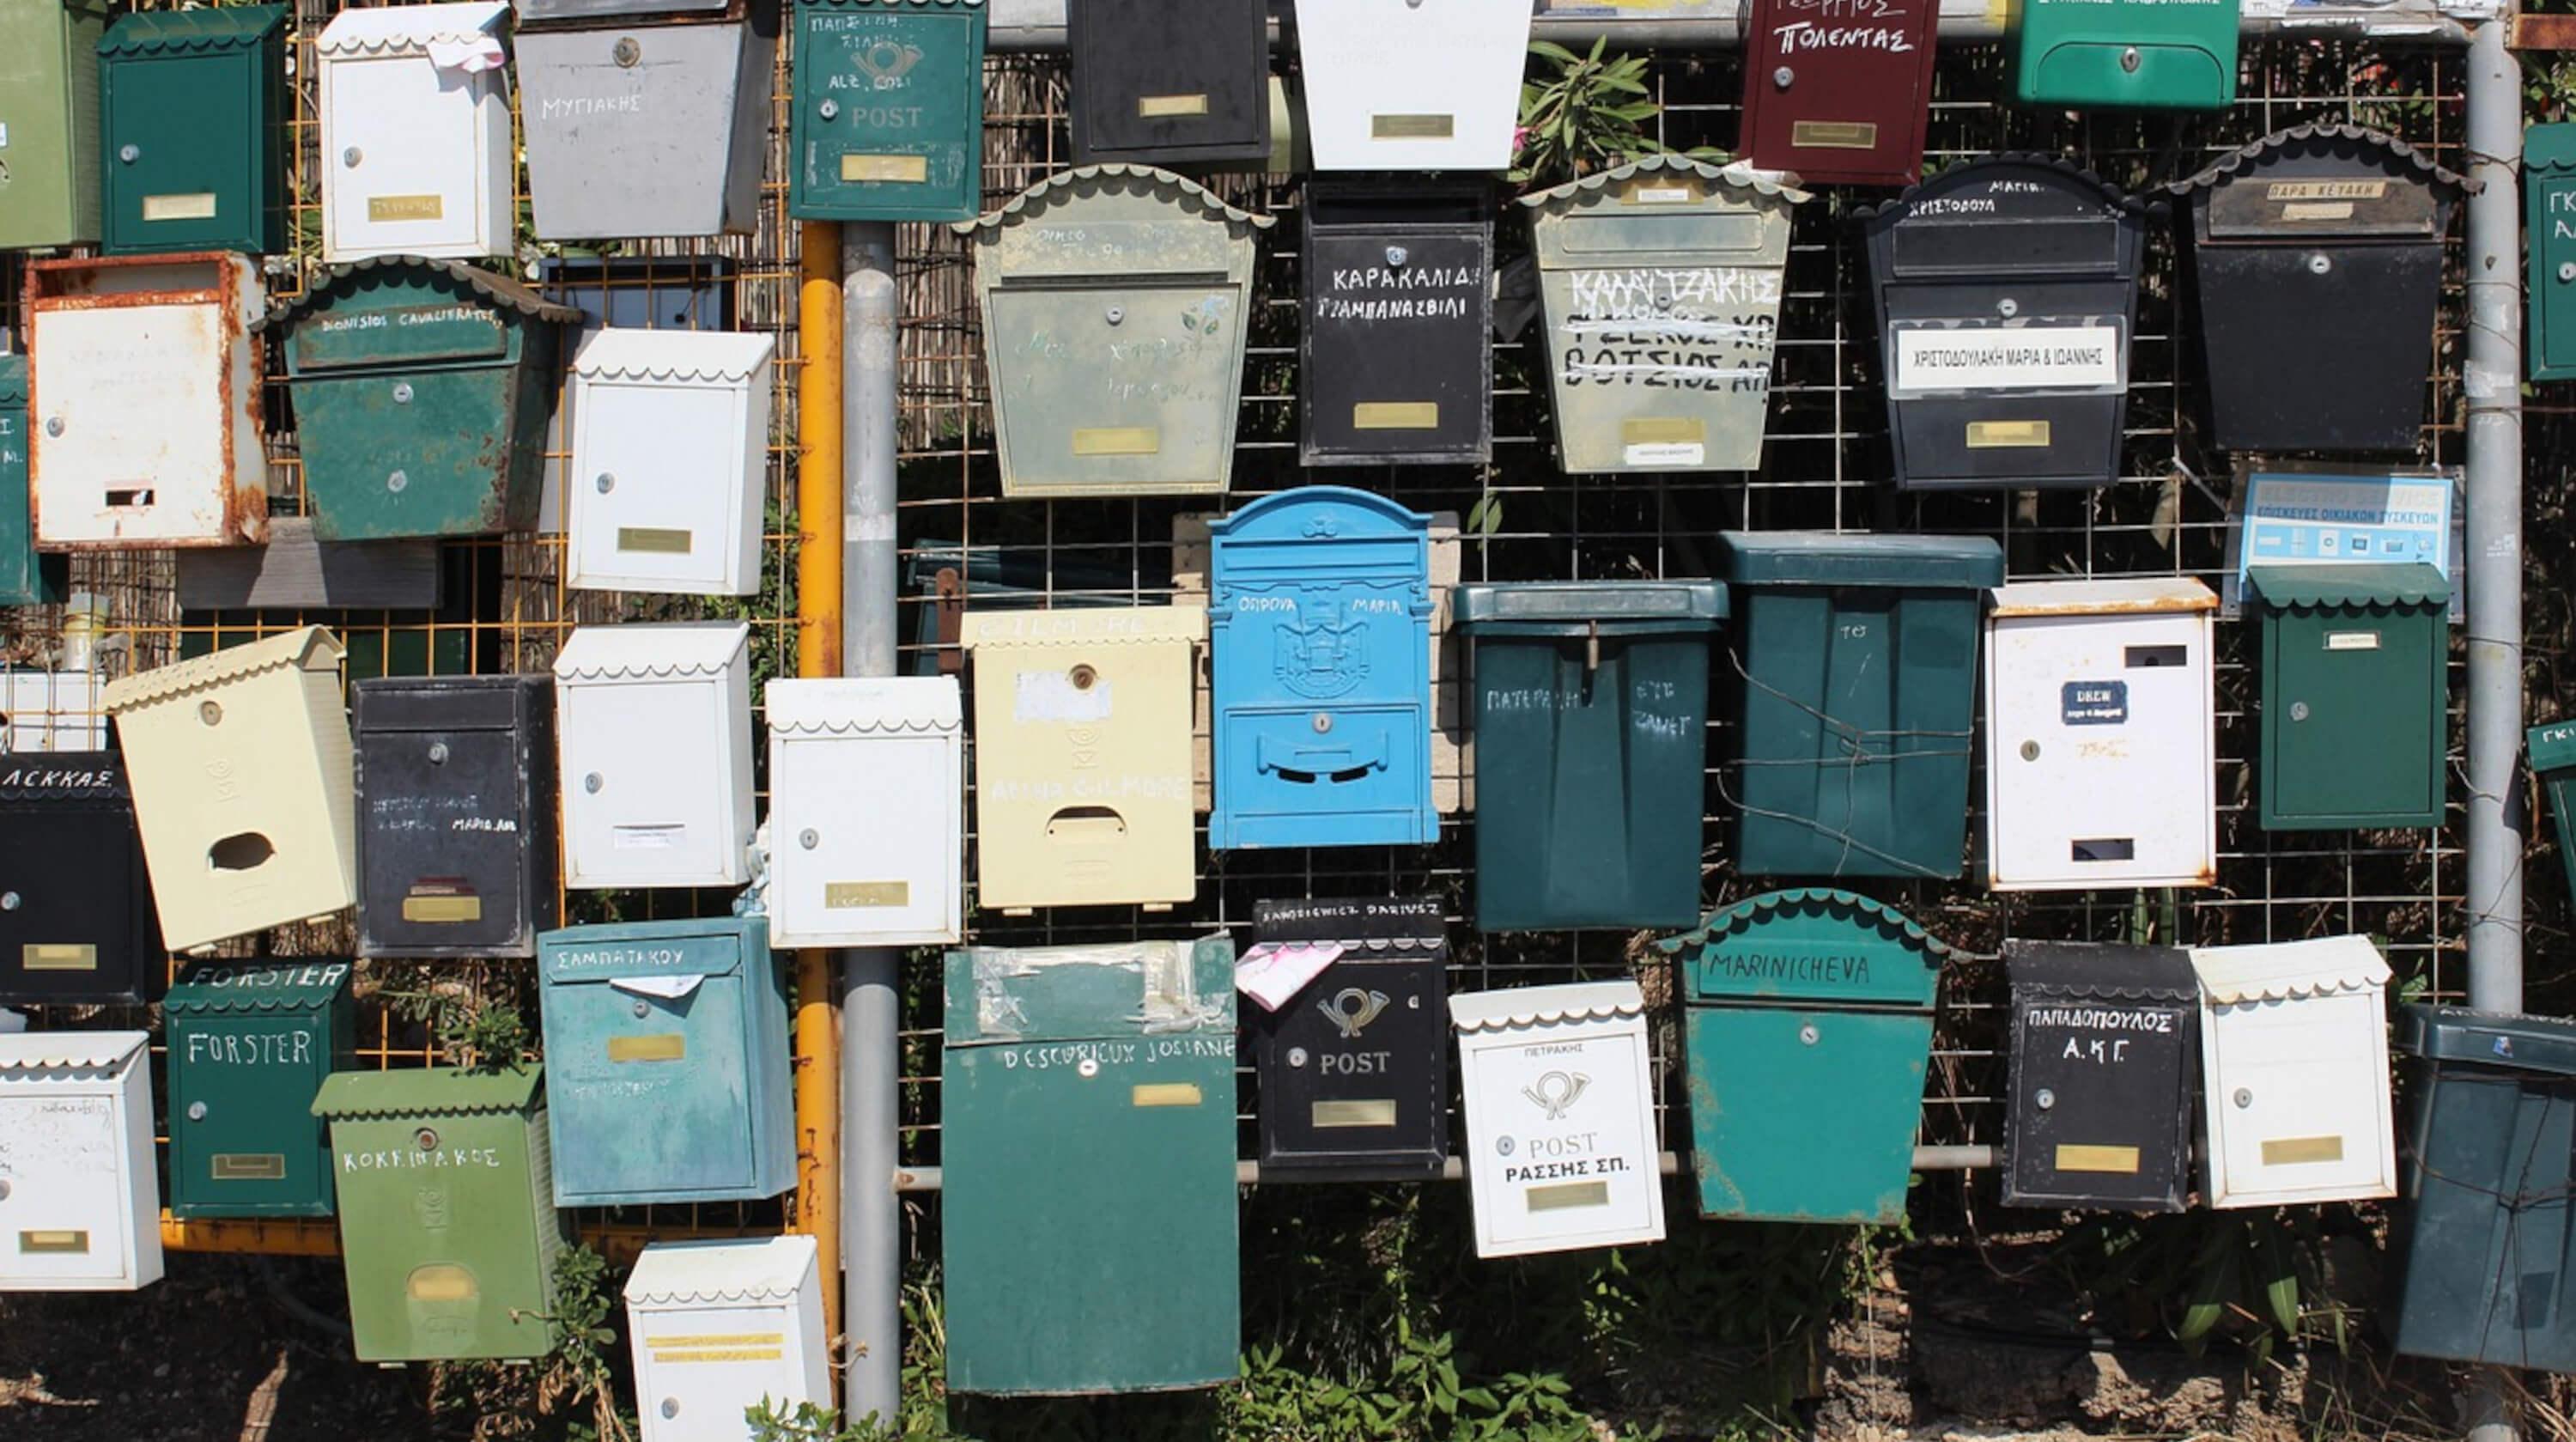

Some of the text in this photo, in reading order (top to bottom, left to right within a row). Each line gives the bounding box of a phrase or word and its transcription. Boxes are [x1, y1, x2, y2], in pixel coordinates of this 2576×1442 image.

[1773, 21, 1914, 54] ΠΟΛΕΝΤΑΣ
[542, 94, 641, 119] ΜΥΓΙΑΚΗΣ
[852, 107, 922, 128] POST
[2006, 349, 2041, 367] ΜΑΡΙΑ
[2043, 349, 2052, 366] &
[188, 963, 348, 988] FORSTER
[1709, 954, 1870, 984] MARINICHEVA
[2029, 1008, 2173, 1033] ΠΑΠΑΔΟΠΟΥΛΟΣ
[188, 1030, 312, 1065] FORSTER
[1524, 1043, 1584, 1057] ΠΕΤΡΑΚΗΣ
[1320, 1050, 1391, 1075] POST
[1528, 1131, 1598, 1159] POST
[1505, 1156, 1631, 1183] ΡΑΣΣΗΣ ΣΠ.
